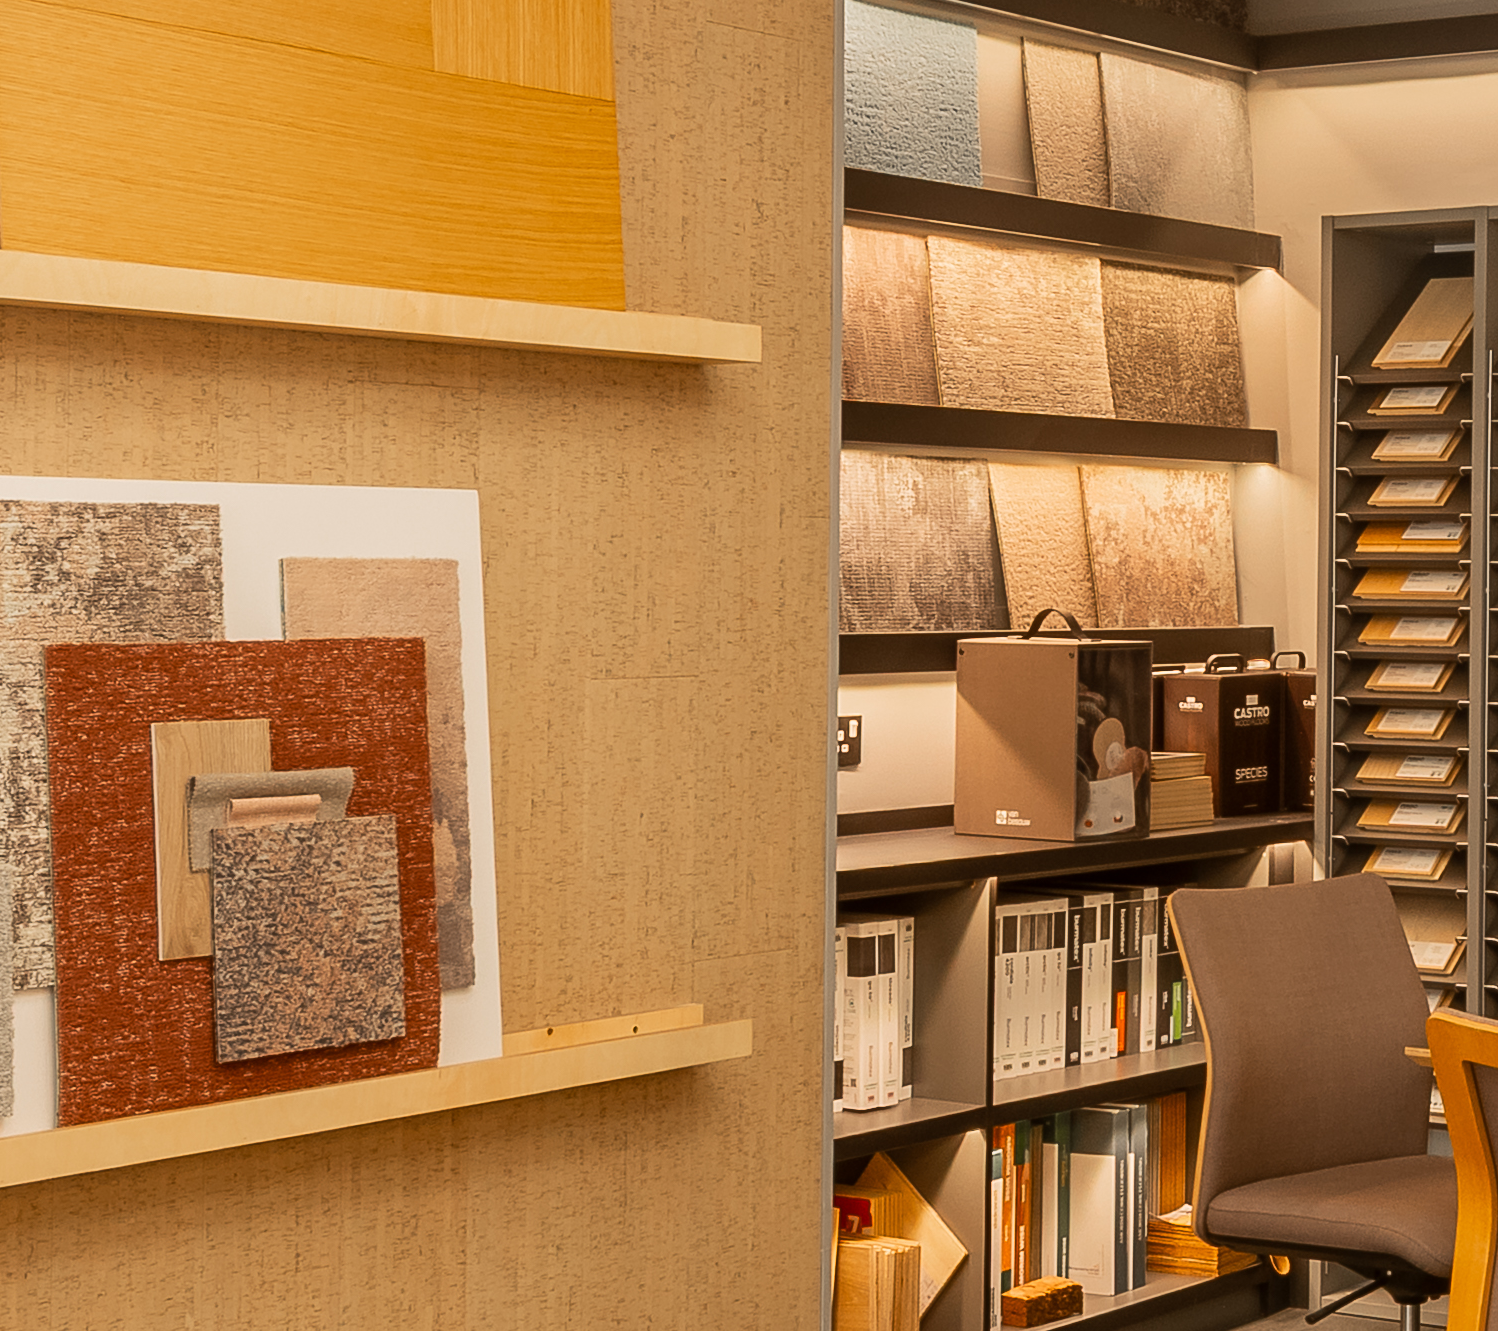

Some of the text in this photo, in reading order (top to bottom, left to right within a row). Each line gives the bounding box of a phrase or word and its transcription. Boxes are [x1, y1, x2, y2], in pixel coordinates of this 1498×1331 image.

[1234, 706, 1270, 719] CASTRO
[1235, 766, 1268, 780] SPECIES
[1073, 915, 1081, 961] burmatex
